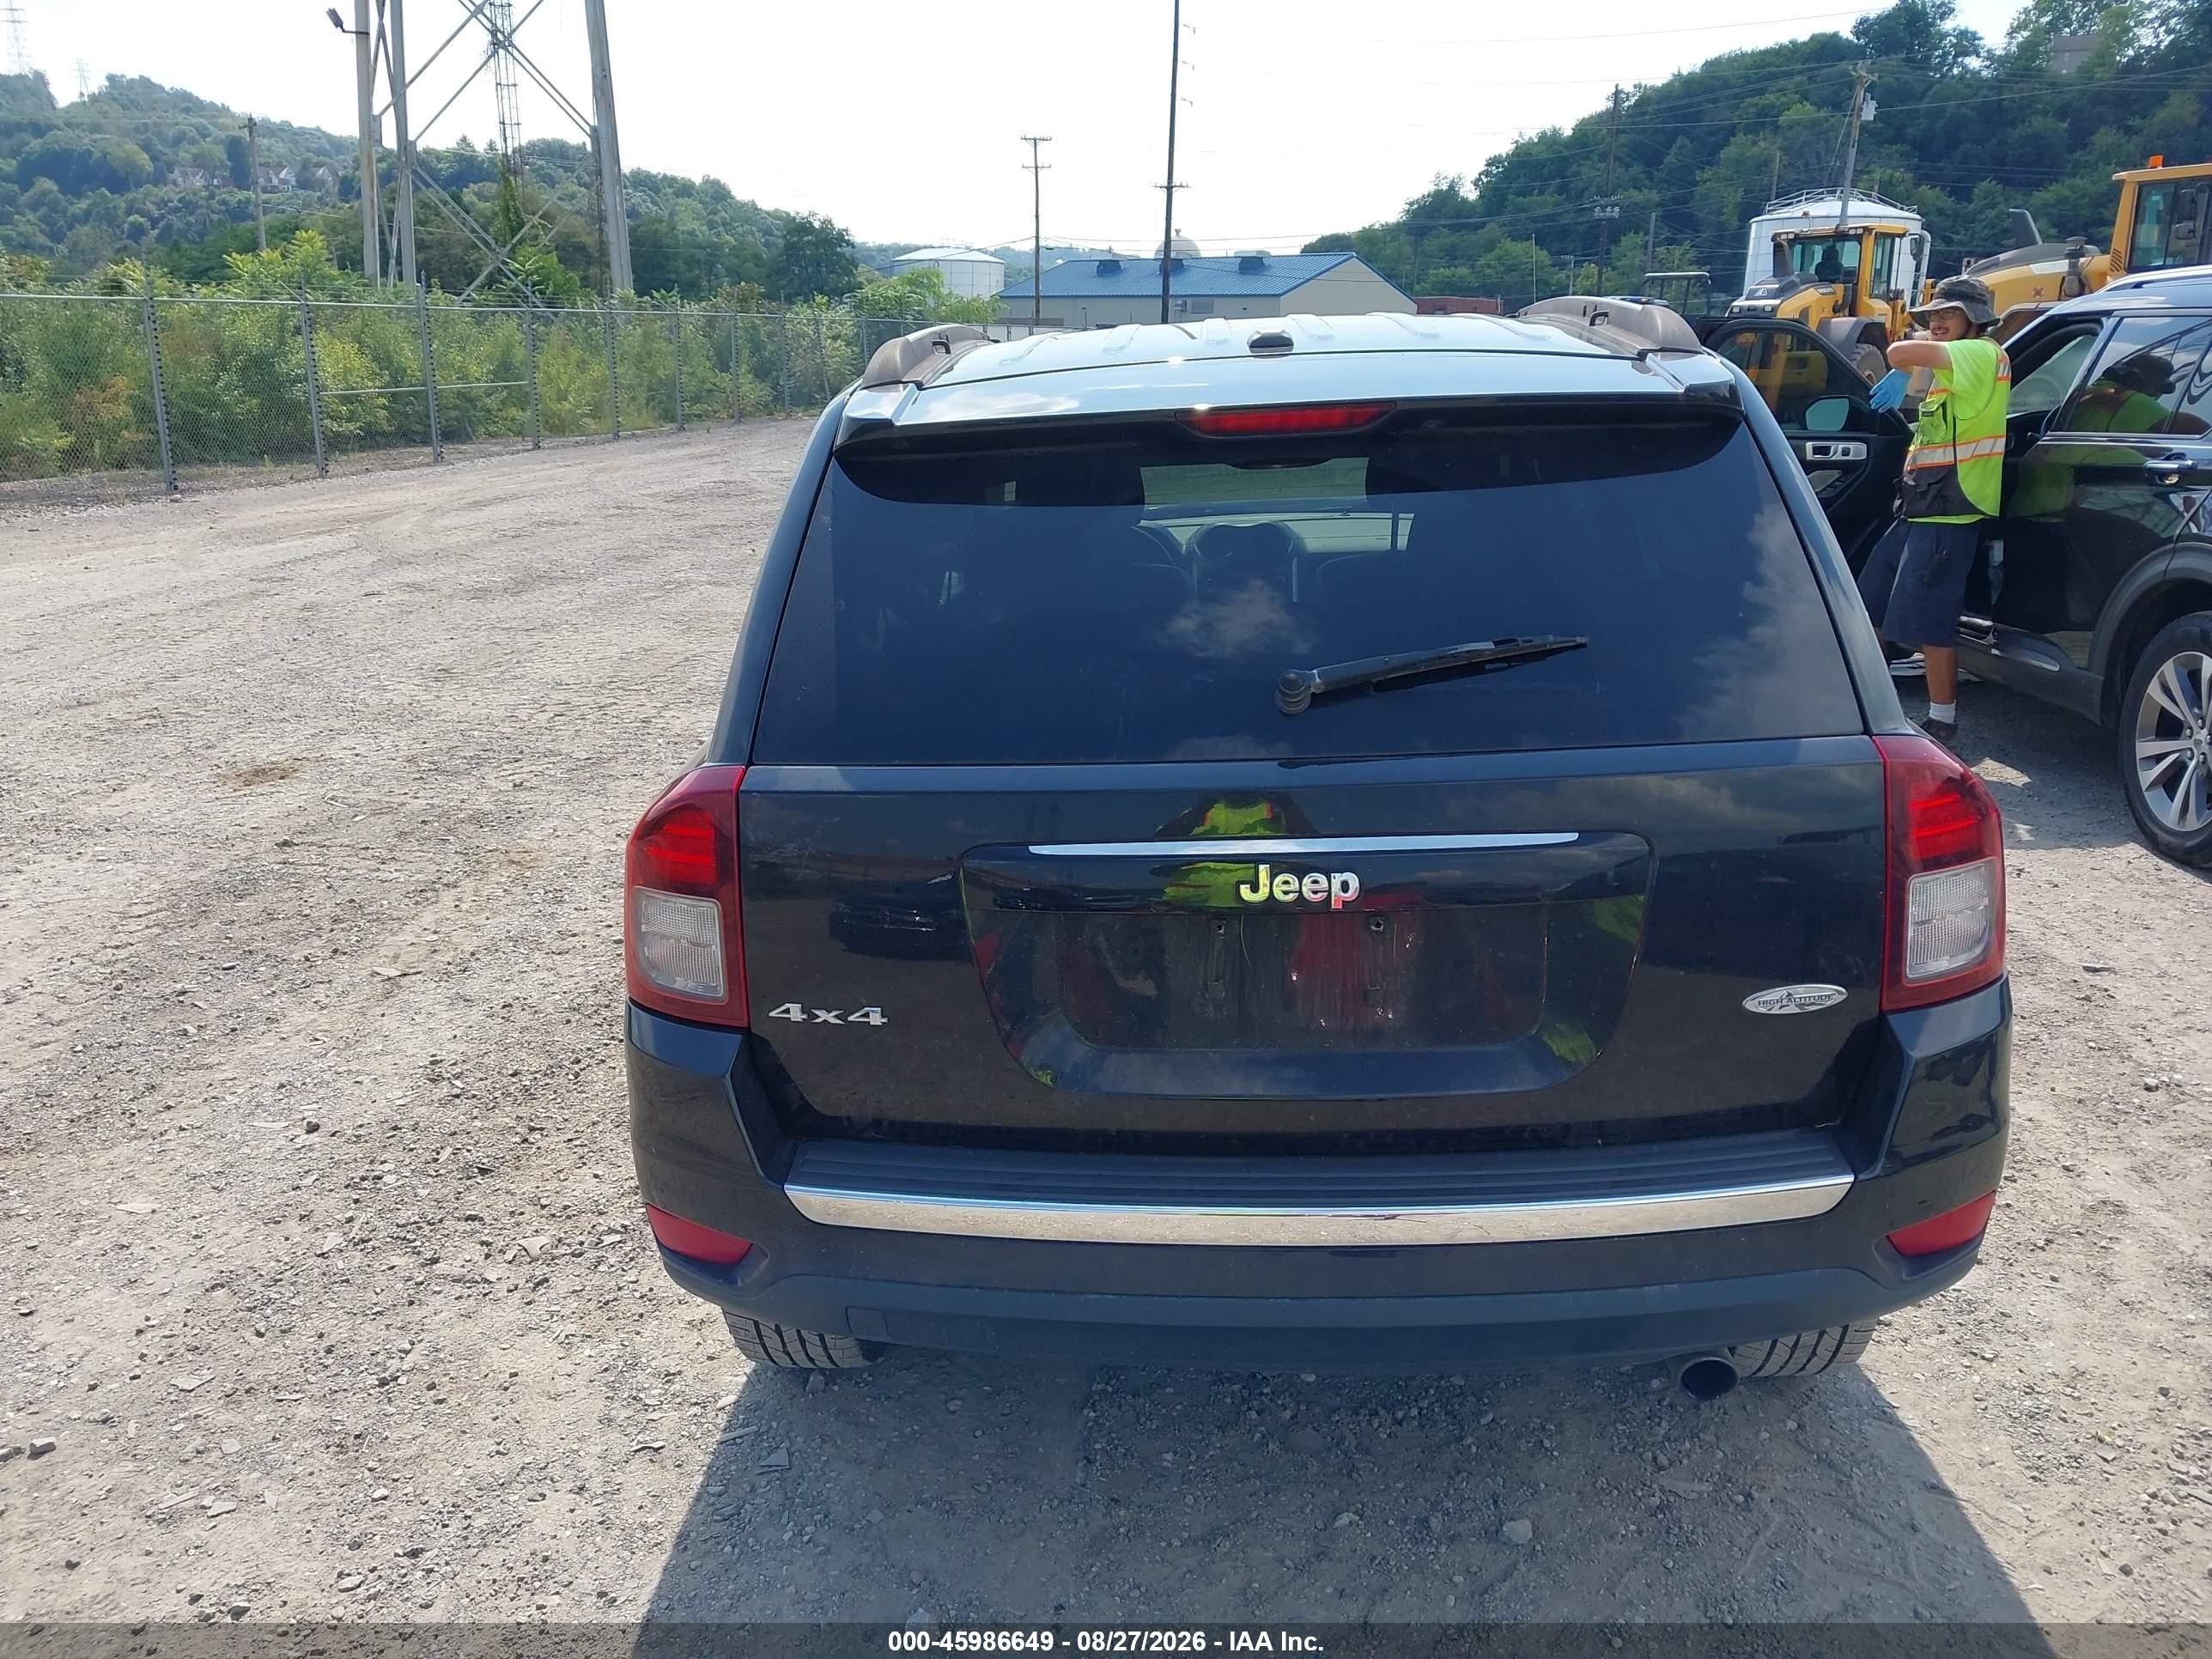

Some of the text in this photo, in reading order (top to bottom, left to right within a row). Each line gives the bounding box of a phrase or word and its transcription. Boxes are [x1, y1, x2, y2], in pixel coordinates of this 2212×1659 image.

[1238, 864, 1360, 909] Jeep
[1758, 994, 1834, 1006] HIGH ALTITUDE
[768, 1003, 889, 1026] 4x4
